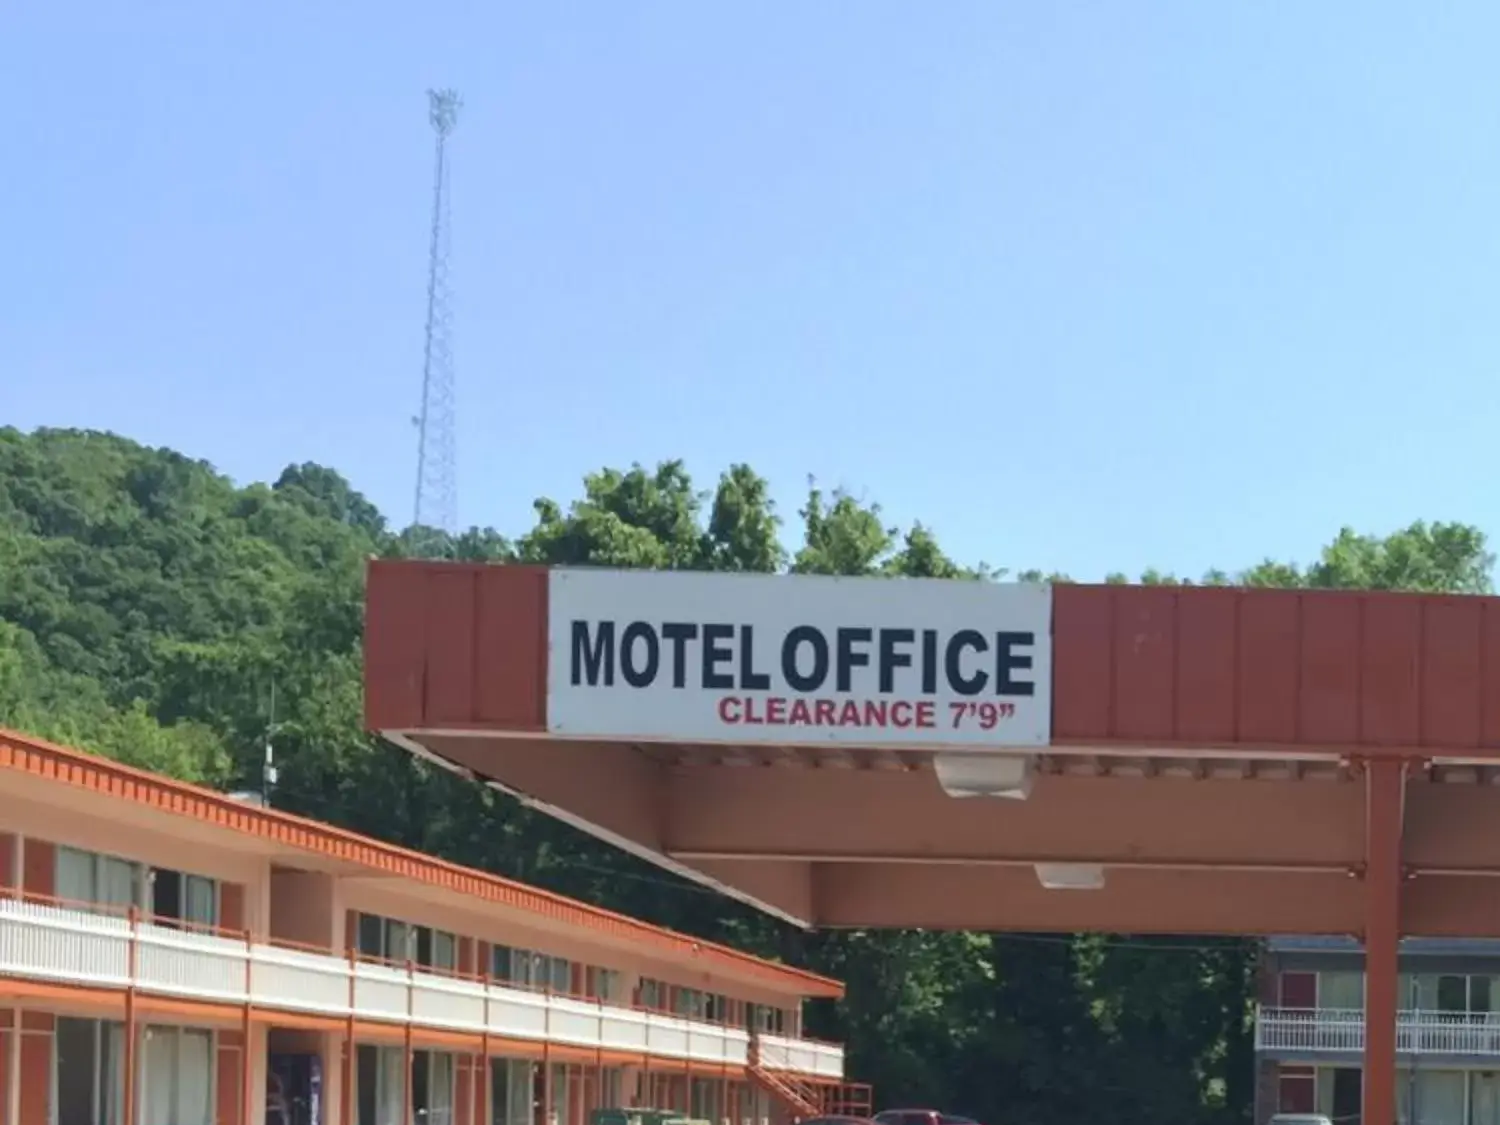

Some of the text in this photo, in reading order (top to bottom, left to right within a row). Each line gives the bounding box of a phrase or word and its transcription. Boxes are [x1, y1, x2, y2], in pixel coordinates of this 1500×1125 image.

[571, 620, 1035, 696] MOTEL OFFICE
[718, 697, 936, 728] CLEARANCE
